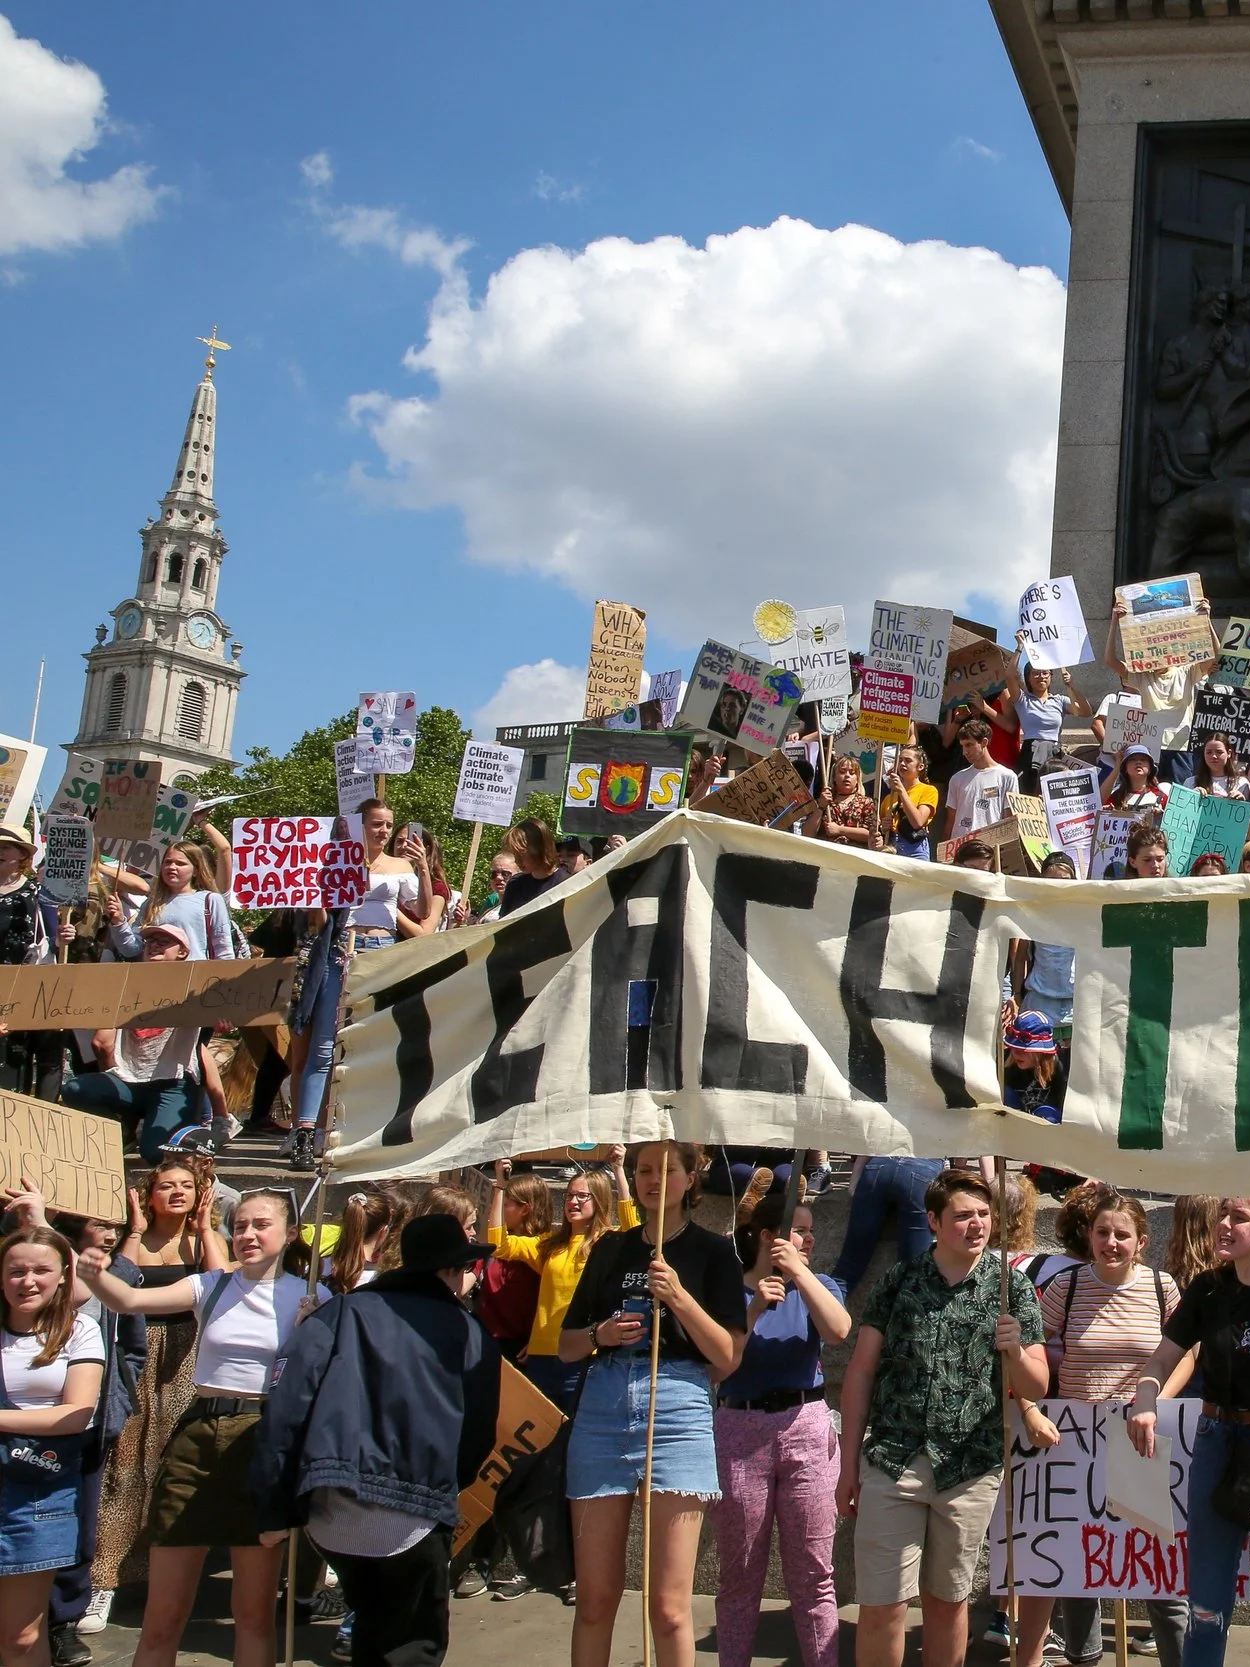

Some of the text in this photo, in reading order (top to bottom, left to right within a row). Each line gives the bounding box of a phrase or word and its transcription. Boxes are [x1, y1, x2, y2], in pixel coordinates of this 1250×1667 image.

[1022, 583, 1061, 608] THERE'S
[602, 607, 643, 637] WHY
[875, 608, 907, 632] THE
[1140, 621, 1190, 636] PLASTIC
[600, 630, 644, 650] GET AN
[872, 630, 944, 658] CLIMATE IS
[1147, 632, 1187, 645] BELONGS
[1223, 623, 1245, 650] 2
[591, 644, 643, 660] Education
[1148, 647, 1168, 656] THE
[1164, 651, 1210, 665] THE SEA
[591, 657, 629, 673] When
[701, 657, 732, 675] GETS
[739, 657, 762, 675] THE
[775, 650, 846, 672] CLIMATE
[588, 671, 636, 691] Nobody
[656, 672, 674, 687] ACT
[865, 672, 904, 688] Climate
[653, 687, 675, 698] NOW
[864, 687, 909, 702] refugees
[1204, 695, 1223, 705] THE
[374, 698, 401, 716] SAVE
[863, 700, 908, 715] welcome
[1127, 710, 1147, 723] CUT
[1193, 712, 1237, 733] INTEGRAL
[891, 727, 907, 735] chaos
[1112, 719, 1158, 737] EMISSIONS
[1123, 732, 1143, 744] NOT
[357, 750, 408, 770] PLANET
[469, 747, 509, 762] Climate
[106, 762, 126, 775] IF
[466, 759, 501, 772] action,
[464, 768, 504, 782] climate
[339, 778, 352, 791] jobs
[461, 780, 513, 795] jobs now!
[717, 768, 759, 802] WHAT
[726, 765, 791, 813] STAND FOR
[751, 787, 786, 815] WHAT
[1009, 795, 1038, 815] ROSES
[1169, 787, 1245, 823] LEARN TO
[50, 827, 85, 838] SYSTEM
[242, 818, 319, 845] STOP
[1104, 820, 1118, 831] WE
[1163, 809, 1224, 842] CHANGE
[50, 838, 87, 848] CHANGE
[50, 850, 66, 858] NOT
[234, 841, 364, 870] TRYING TO
[48, 860, 86, 869] CLIMATE
[46, 869, 84, 879] CHANGE
[234, 867, 366, 892] MAKE COAL
[32, 977, 141, 1020] Nature not
[374, 842, 986, 1148] TEACH
[28, 1105, 121, 1171] NATURE
[41, 1152, 123, 1221] BETTER
[11, 1447, 61, 1472] ellesse
[997, 1530, 1064, 1589] IS
